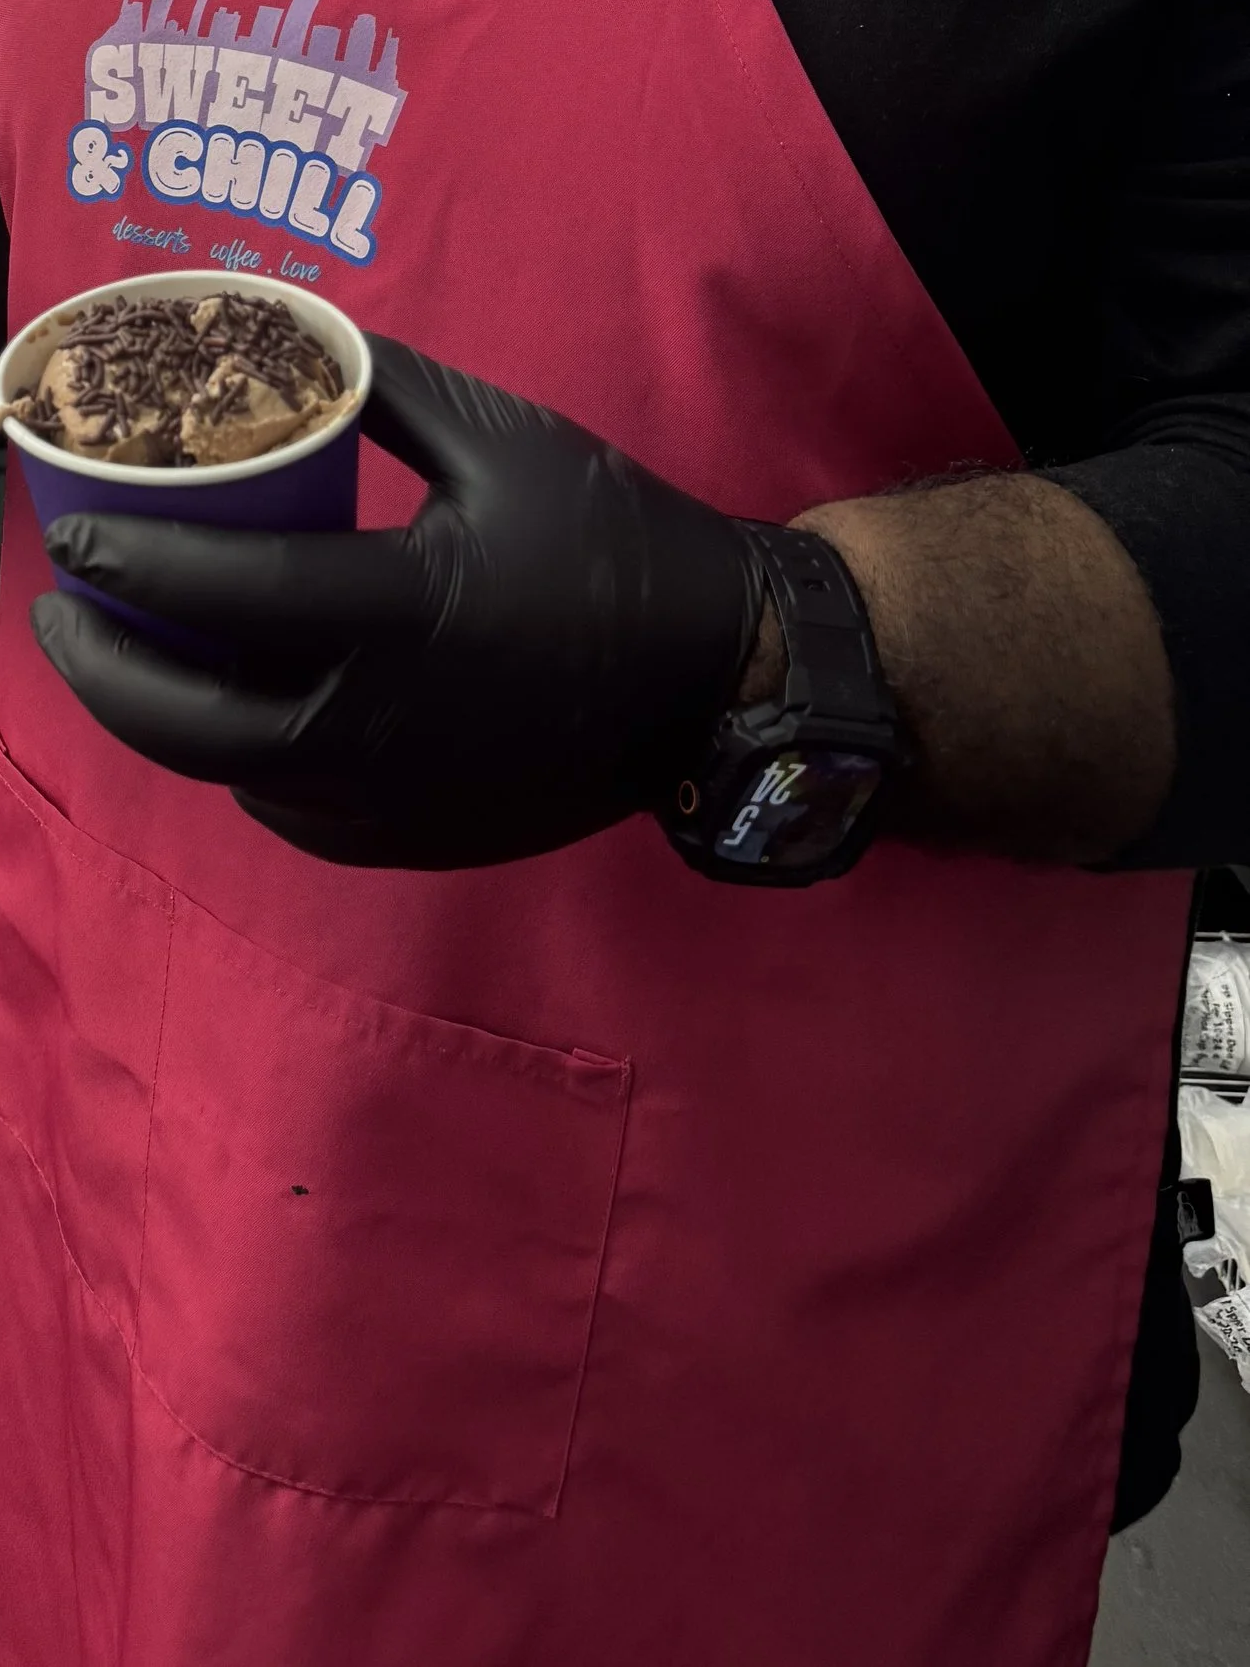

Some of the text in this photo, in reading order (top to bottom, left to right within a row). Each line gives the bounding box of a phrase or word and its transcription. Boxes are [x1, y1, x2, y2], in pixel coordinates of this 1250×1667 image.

[90, 41, 398, 172] SWEET
[70, 124, 378, 261] & CHILL
[112, 215, 192, 255] desserts
[210, 238, 263, 271] coffee
[280, 251, 321, 281] love
[750, 761, 807, 805] 24
[722, 804, 760, 846] 5
